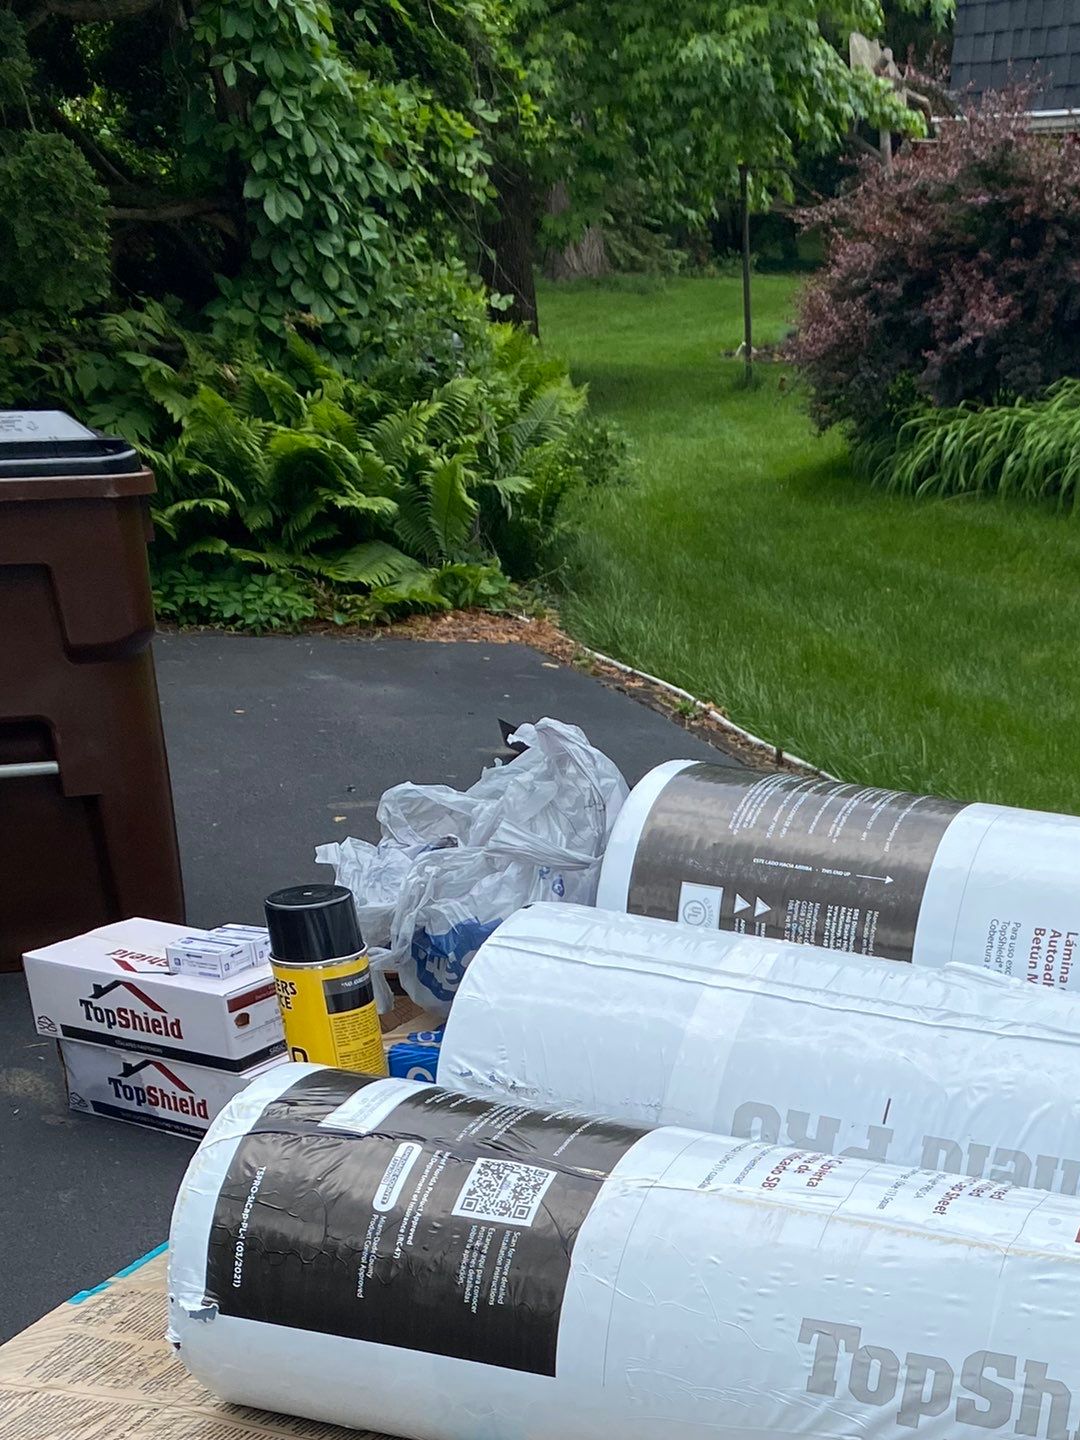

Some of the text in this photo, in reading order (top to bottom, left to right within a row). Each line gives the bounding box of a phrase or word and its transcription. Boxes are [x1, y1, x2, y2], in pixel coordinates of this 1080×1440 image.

[1027, 926, 1047, 969] Betún
[1058, 931, 1079, 985] Lámina
[79, 997, 184, 1041] TopShield
[107, 1076, 209, 1121] TopShield
